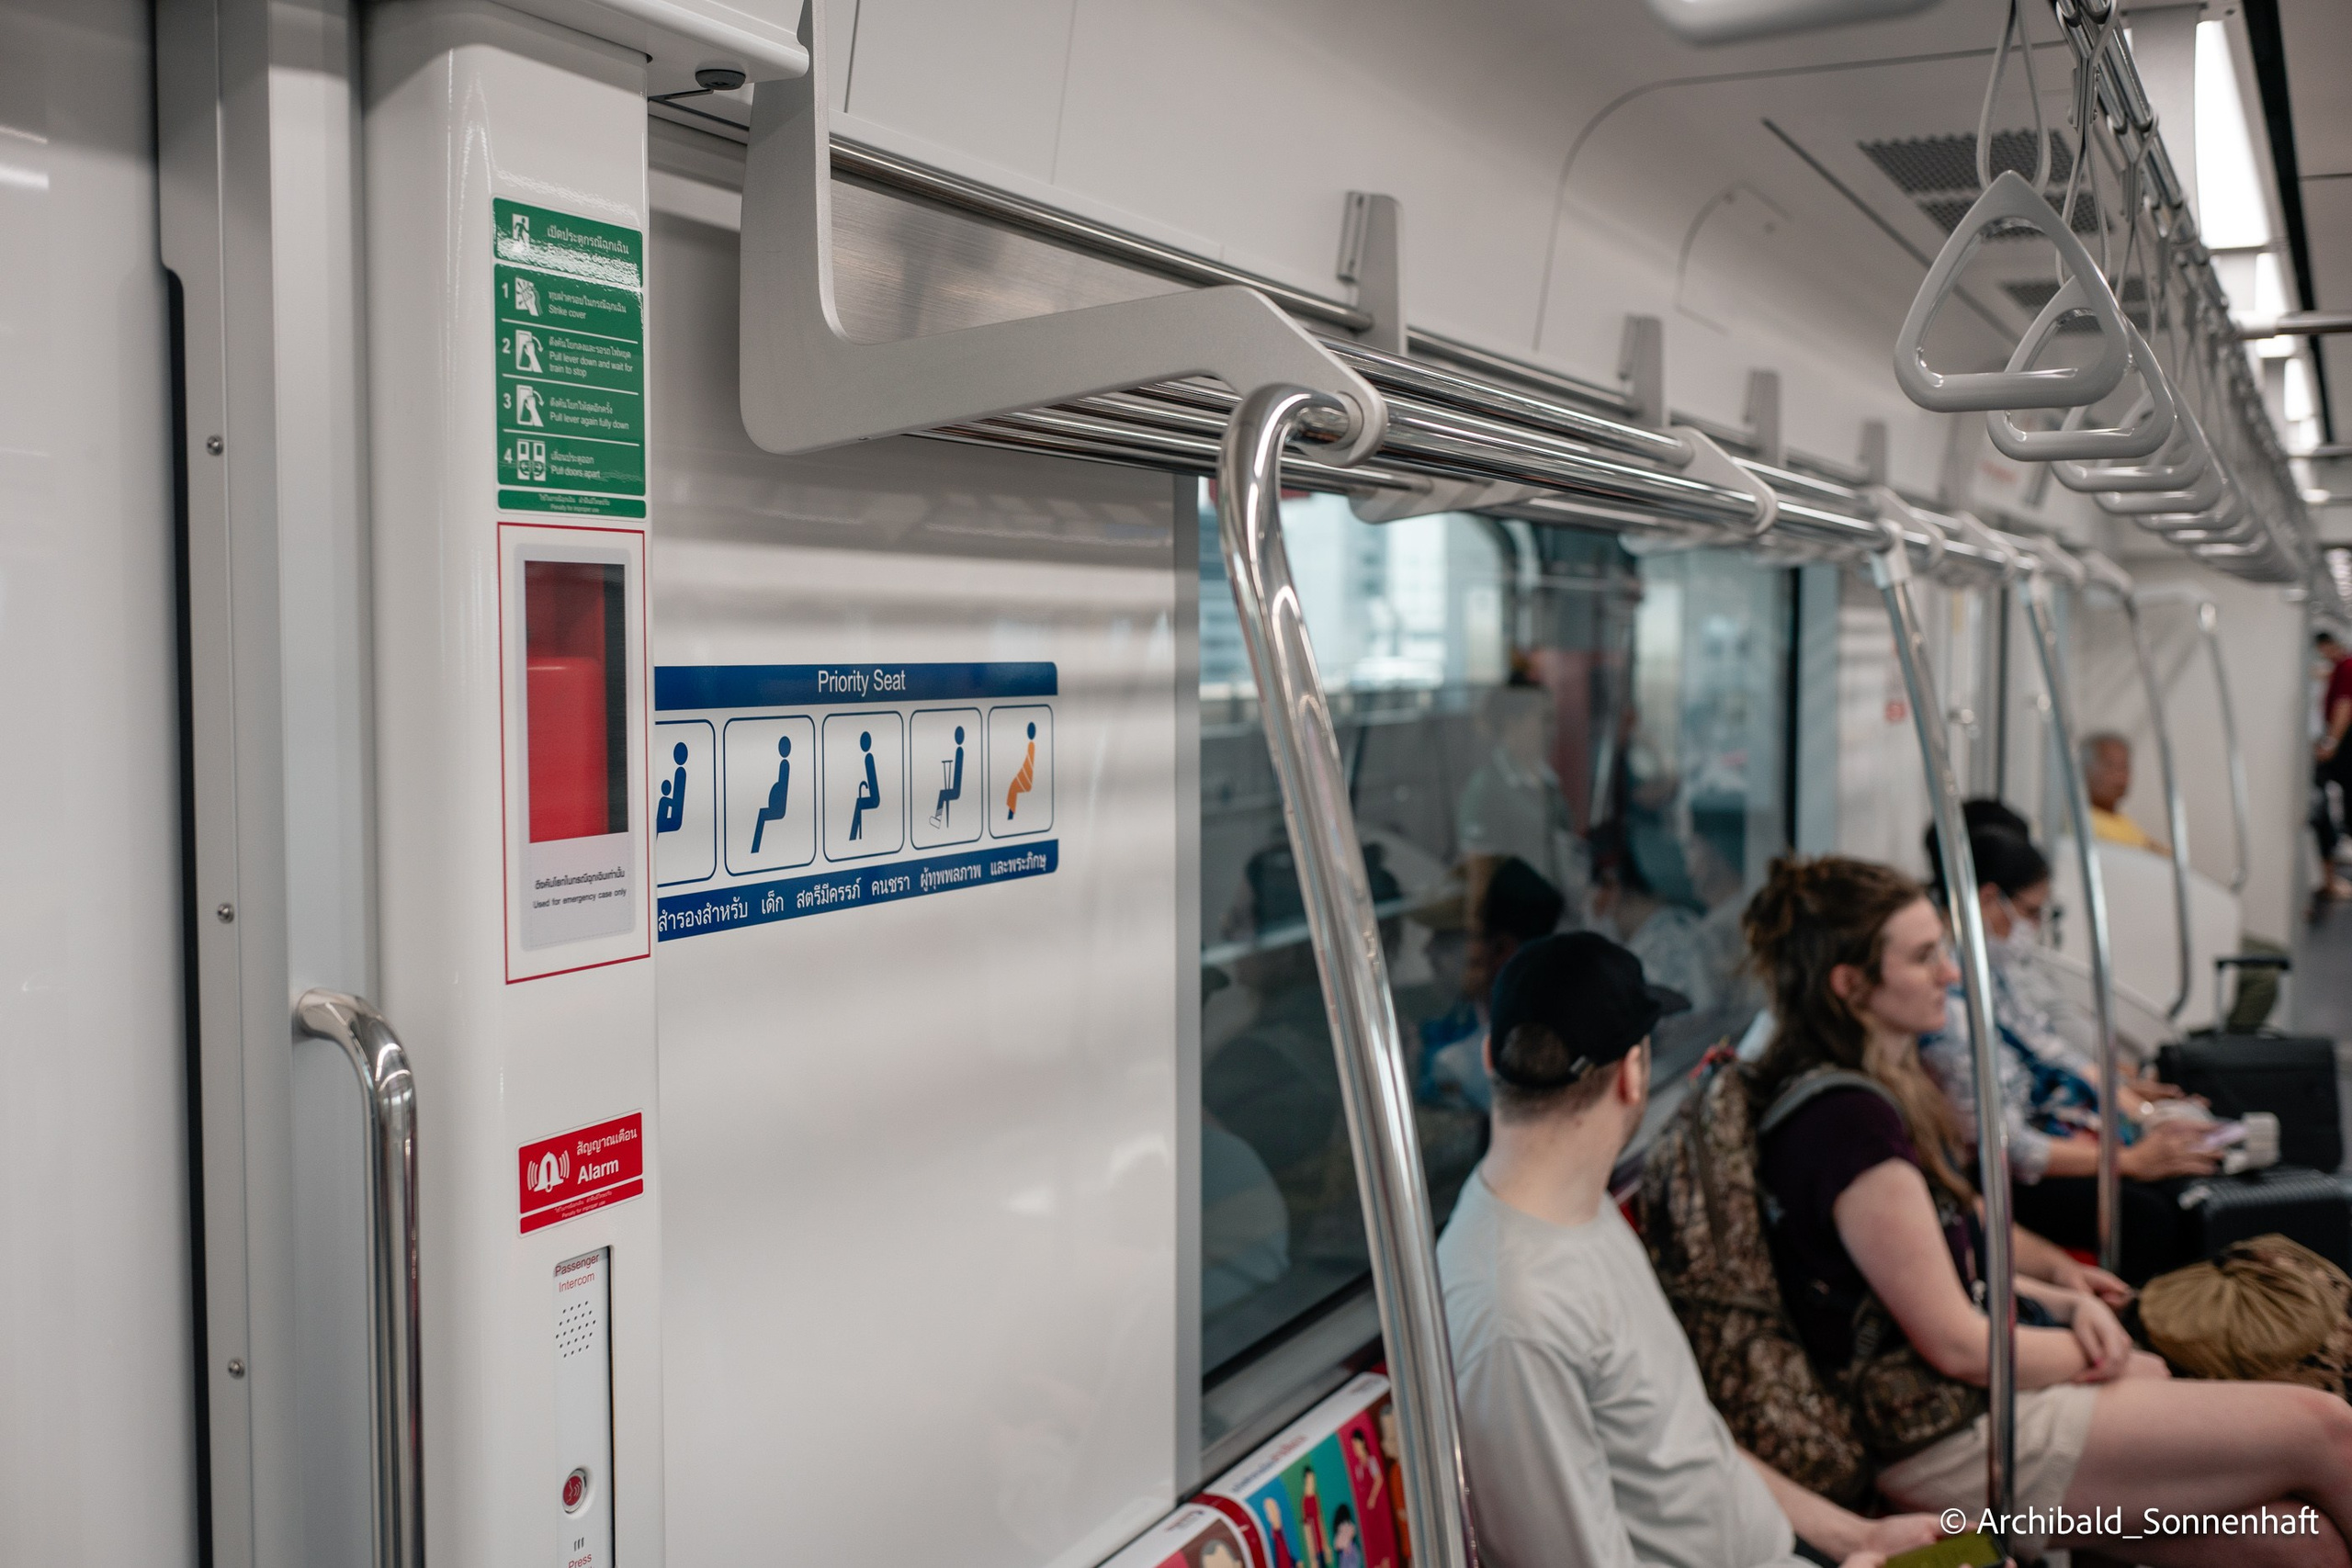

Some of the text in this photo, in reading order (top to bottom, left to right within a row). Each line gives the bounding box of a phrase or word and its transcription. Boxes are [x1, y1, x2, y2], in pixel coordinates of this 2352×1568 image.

[502, 283, 509, 299] 1
[548, 304, 587, 320] Strike cover
[502, 338, 511, 355] 2
[549, 351, 634, 373] Pull lever down and wait for
[549, 364, 587, 378] train to stop
[503, 392, 512, 409] 3
[549, 412, 629, 430] Pull lever again fully down
[503, 448, 513, 464] 4
[550, 465, 601, 480] Pull doors apart
[818, 669, 906, 697] Priority Seat
[533, 888, 627, 908] Used for emergency case only
[658, 852, 1046, 932] สำรองสำหรับ เด็ก สตรีมีครรภ์ คนชรา ผู้ทุพพลภาพ และพระภิกษุ
[576, 1128, 639, 1156] สัญญาณเตือน
[577, 1159, 619, 1185] Alarm
[555, 1254, 599, 1277] Passenger
[559, 1272, 595, 1292] Intercom
[568, 1553, 592, 1568] Press
